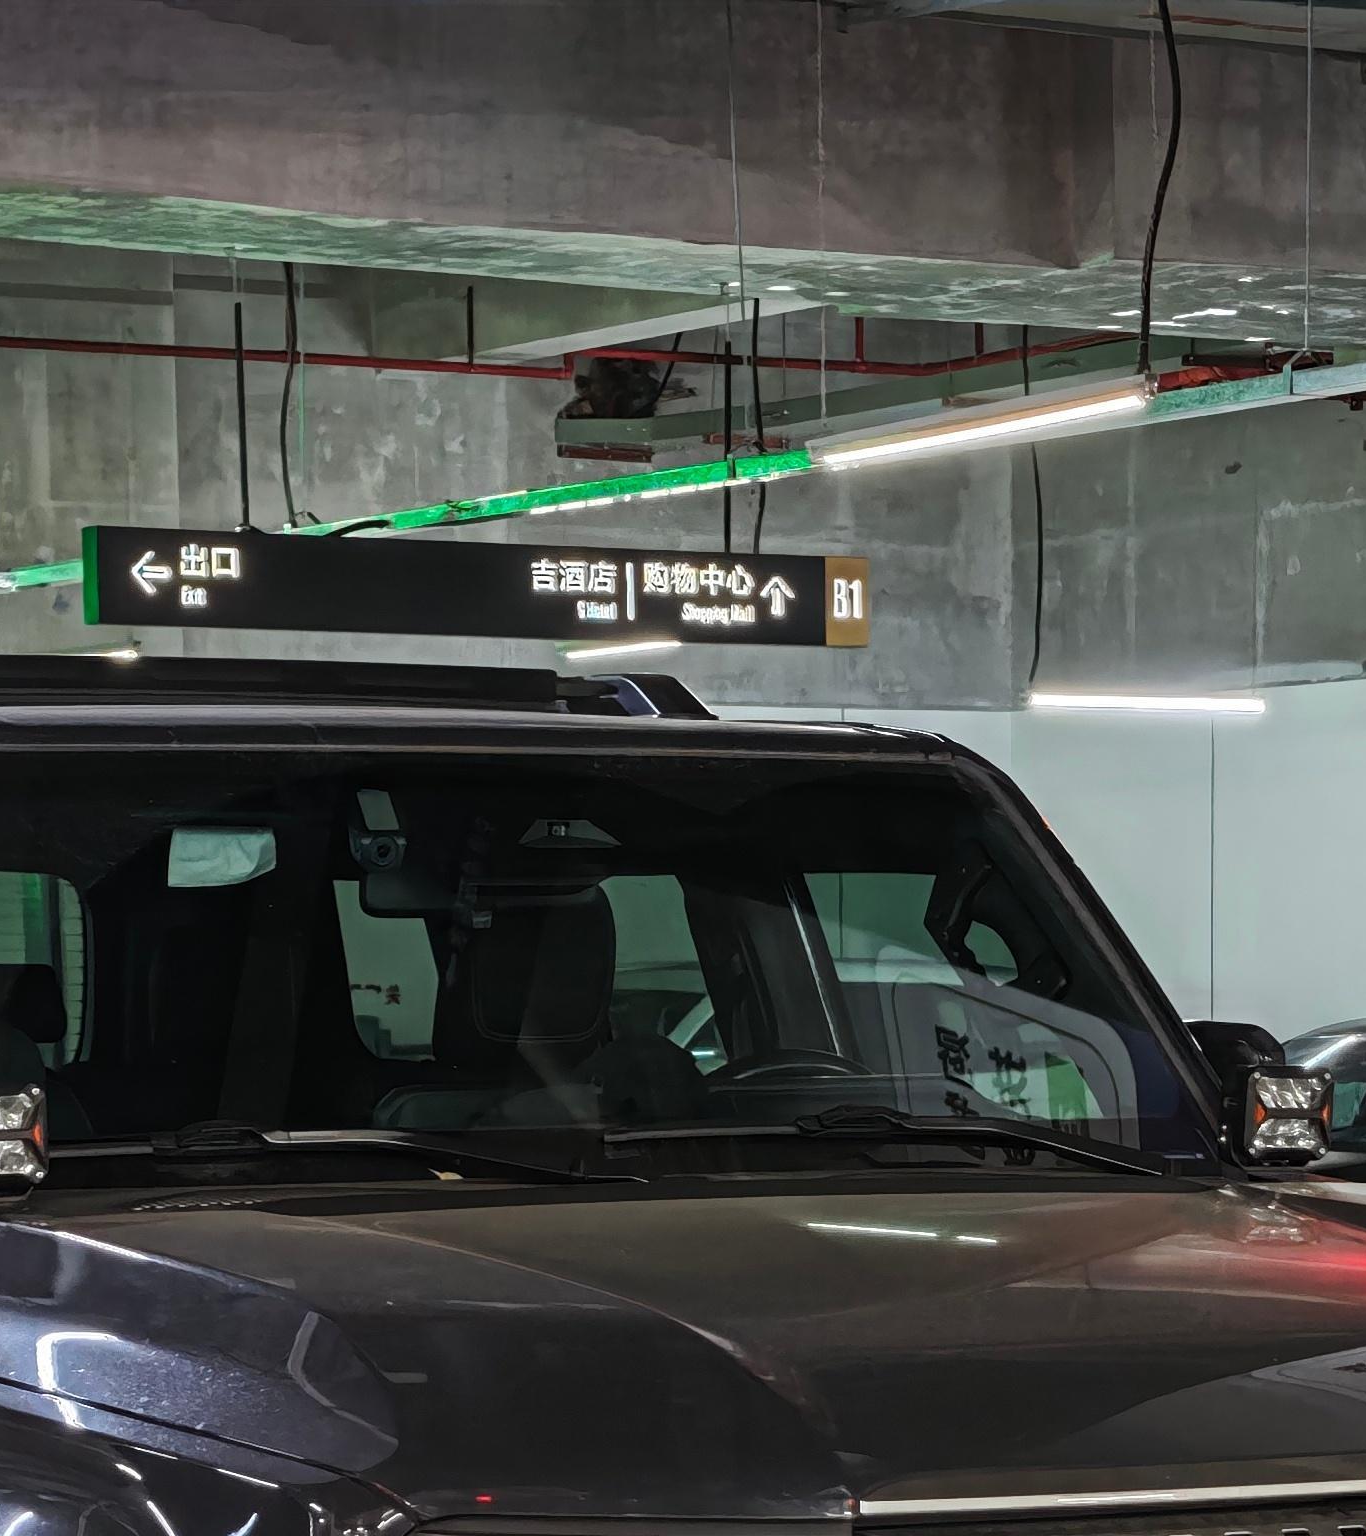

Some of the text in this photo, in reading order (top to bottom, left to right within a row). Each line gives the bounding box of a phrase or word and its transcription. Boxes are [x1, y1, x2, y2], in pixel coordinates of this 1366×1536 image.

[180, 543, 241, 578] 出口
[643, 561, 755, 596] 购物中心
[833, 577, 863, 619] B1
